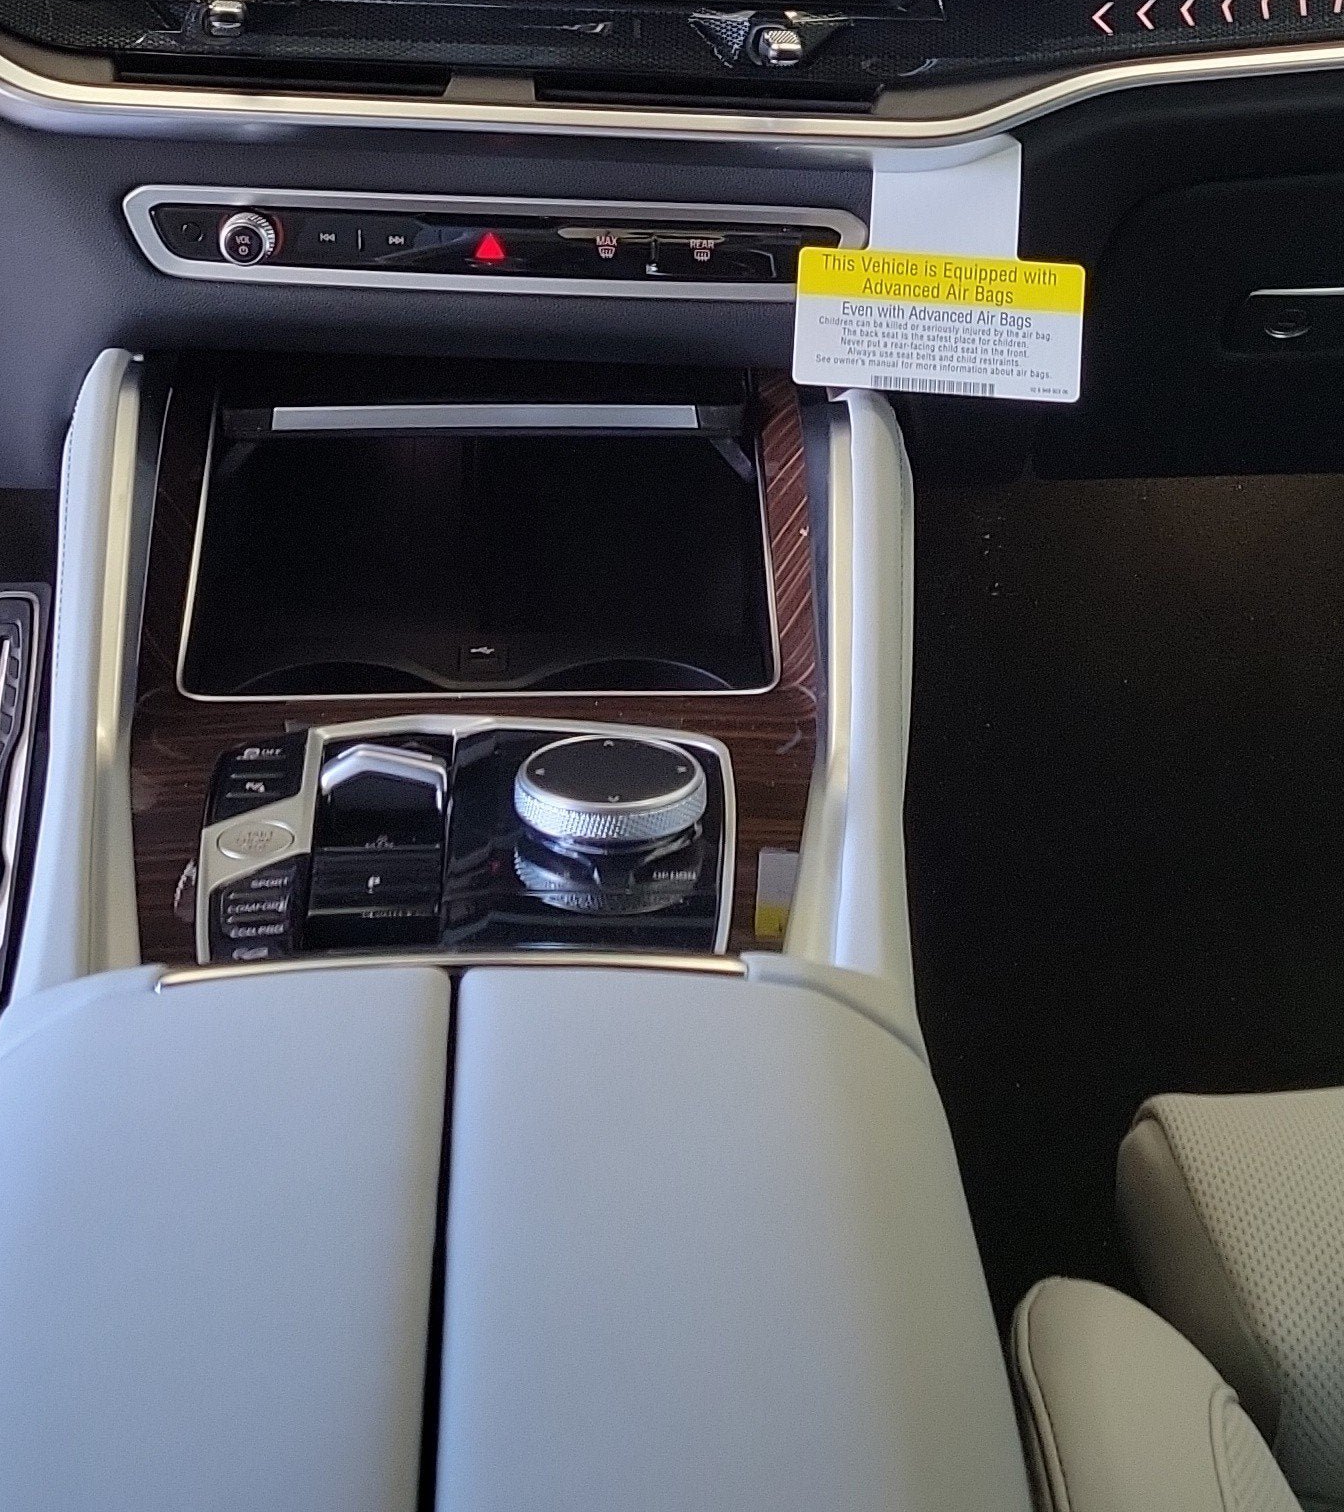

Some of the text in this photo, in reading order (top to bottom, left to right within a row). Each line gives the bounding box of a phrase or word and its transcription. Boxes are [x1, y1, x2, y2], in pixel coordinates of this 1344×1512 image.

[235, 235, 251, 245] VOL
[596, 235, 617, 246] MAX
[689, 239, 715, 249] REAR
[822, 253, 1057, 286] This Vehicle is Equipped with
[862, 278, 1014, 307] Advanced Air Bags
[842, 301, 1032, 330] Even with Advanced Air Bags
[819, 316, 853, 325] Children
[886, 321, 908, 331] killed
[922, 324, 959, 335] seriously
[962, 326, 991, 336] injured
[1006, 329, 1019, 338] the
[842, 327, 857, 336] The
[860, 329, 878, 338] back
[911, 333, 924, 341] the
[926, 334, 951, 343] safest
[954, 336, 976, 345] place
[840, 337, 864, 346] Never
[867, 340, 880, 348] put
[890, 341, 935, 352] rear-facing
[938, 344, 958, 353] child
[961, 346, 978, 354] seat
[991, 348, 1004, 356] the
[847, 347, 876, 358] Always
[896, 351, 913, 359] seat
[916, 352, 936, 361] belts
[938, 354, 954, 362] and
[956, 355, 977, 363] child
[816, 354, 831, 363] See
[833, 357, 865, 366] owner's
[868, 359, 898, 367] manual
[939, 364, 987, 375] information
[990, 368, 1014, 376] about
